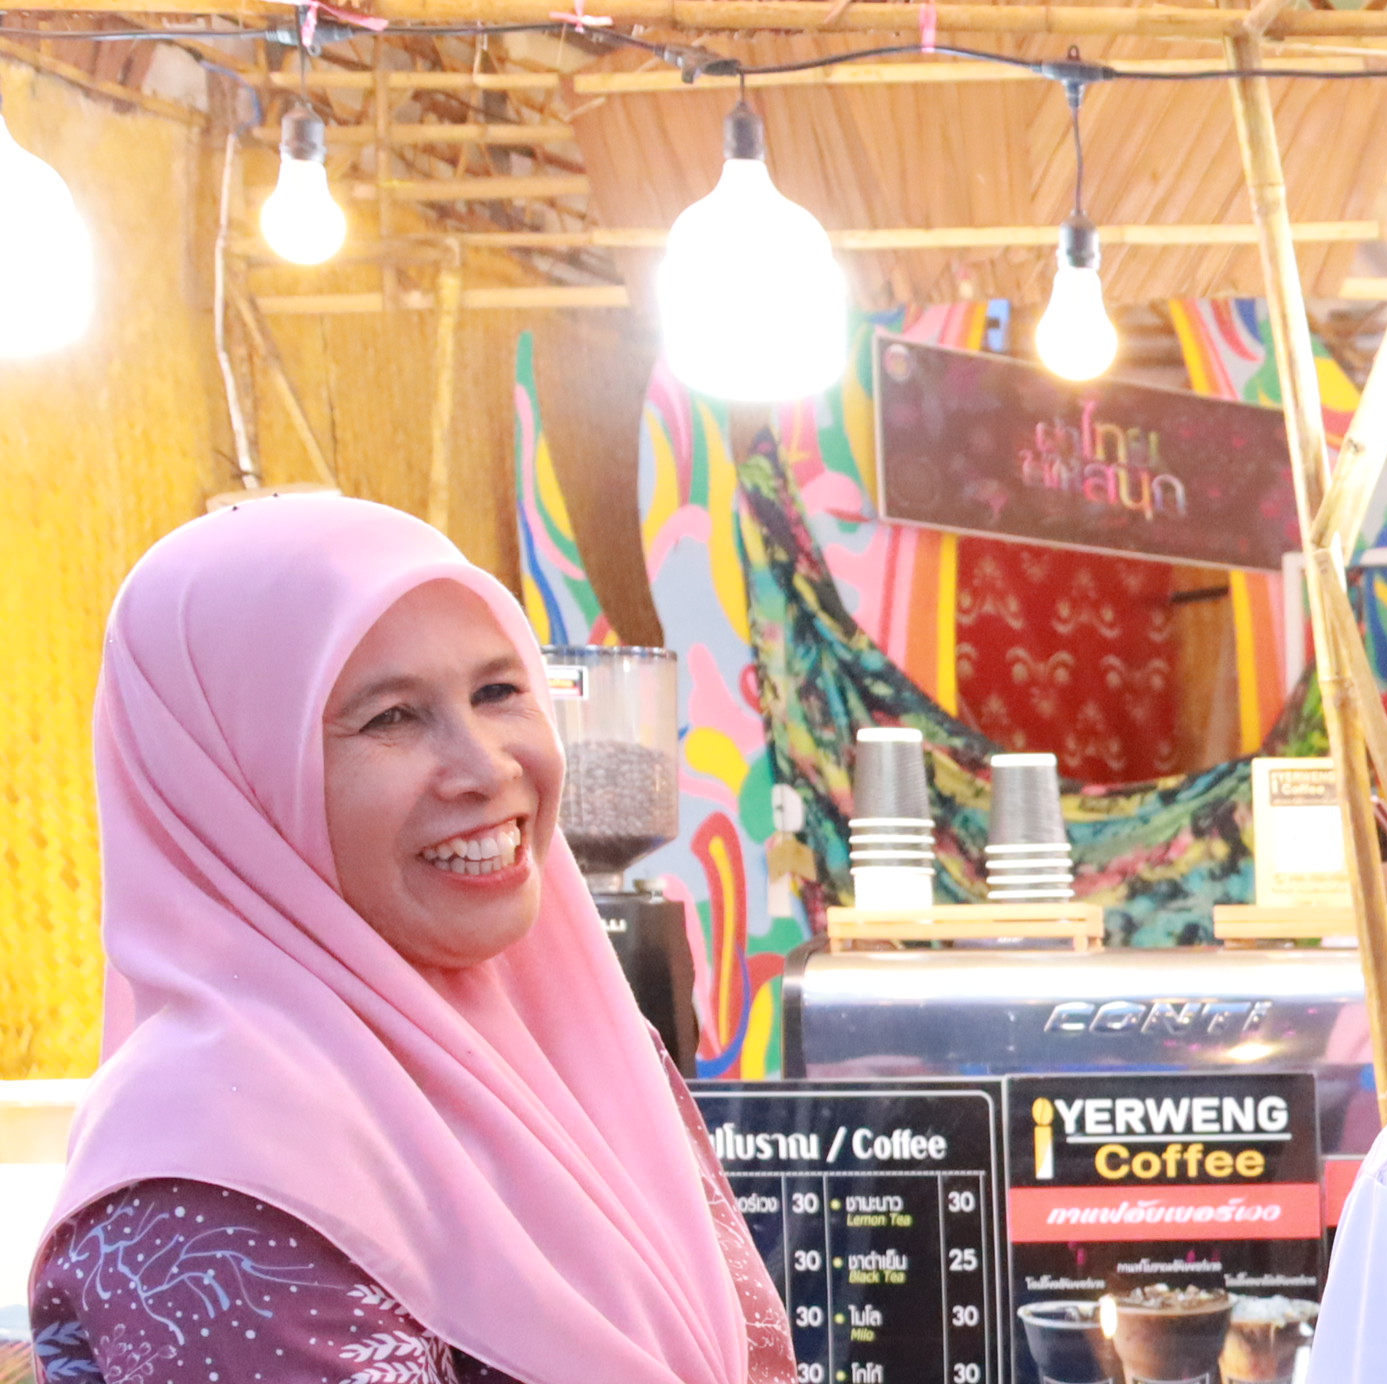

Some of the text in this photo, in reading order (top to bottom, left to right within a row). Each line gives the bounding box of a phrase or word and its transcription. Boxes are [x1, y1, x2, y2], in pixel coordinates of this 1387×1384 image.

[1043, 1001, 1273, 1034] CONTI
[1053, 1096, 1290, 1134] YERWENG
[852, 1128, 948, 1161] Coffee
[1094, 1143, 1266, 1180] Coffee
[792, 1192, 820, 1214] 30
[846, 1191, 976, 1213] ชามะนาว 30
[846, 1212, 913, 1227] Lemon Tea
[794, 1250, 821, 1272] 30
[949, 1248, 979, 1271] 25
[848, 1269, 907, 1284] Black Tea
[796, 1306, 822, 1327] 30
[848, 1304, 980, 1327] ไมโล 30
[850, 1328, 875, 1342] Milo
[798, 1363, 824, 1384] 30
[953, 1363, 982, 1384] 30
